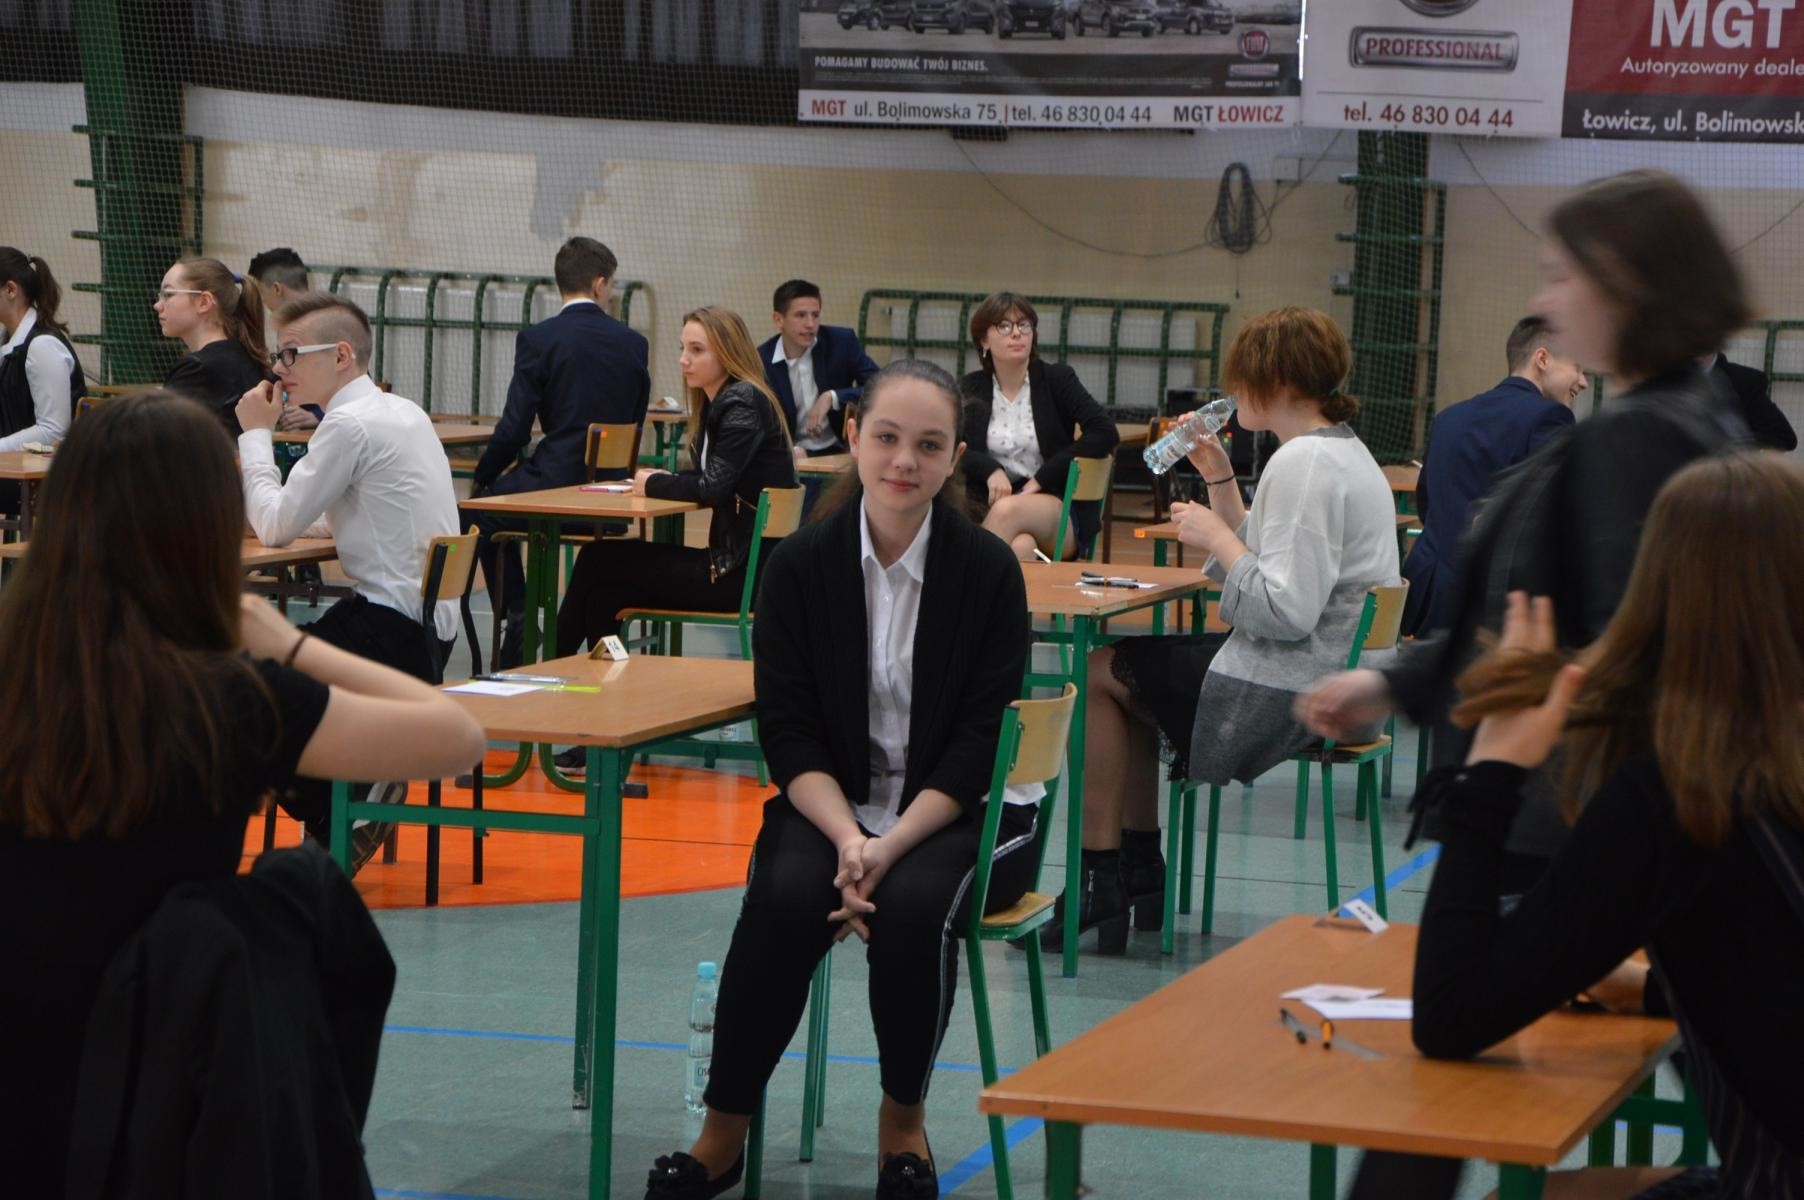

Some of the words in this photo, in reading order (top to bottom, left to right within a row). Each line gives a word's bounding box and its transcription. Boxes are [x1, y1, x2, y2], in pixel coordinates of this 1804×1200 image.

[1650, 0, 1795, 48] MGT
[1365, 38, 1504, 61] PROFESSIONAL
[815, 56, 868, 68] POMAGAMY
[871, 57, 920, 69] BUDOWAĆ
[923, 57, 949, 71] TWÓJ
[1620, 57, 1749, 79] Autoryzowany
[811, 99, 847, 116] MGT
[854, 101, 872, 117] ul.
[878, 101, 971, 119] Bolimowska
[977, 104, 997, 120] 75
[1012, 105, 1036, 121] tel.
[1041, 106, 1063, 121] 46
[1067, 106, 1100, 122] 830
[1104, 106, 1125, 122] 04
[1130, 106, 1152, 122] 44
[1173, 105, 1214, 122] MGT
[1218, 105, 1284, 122] ŁOWICZ
[1344, 101, 1372, 122] tel.
[1379, 104, 1405, 122] 46
[1412, 105, 1449, 124] 830
[1456, 107, 1480, 126] 04
[1488, 109, 1513, 128] 44
[1582, 109, 1656, 133] Łowicz,
[1664, 109, 1687, 131] ul.
